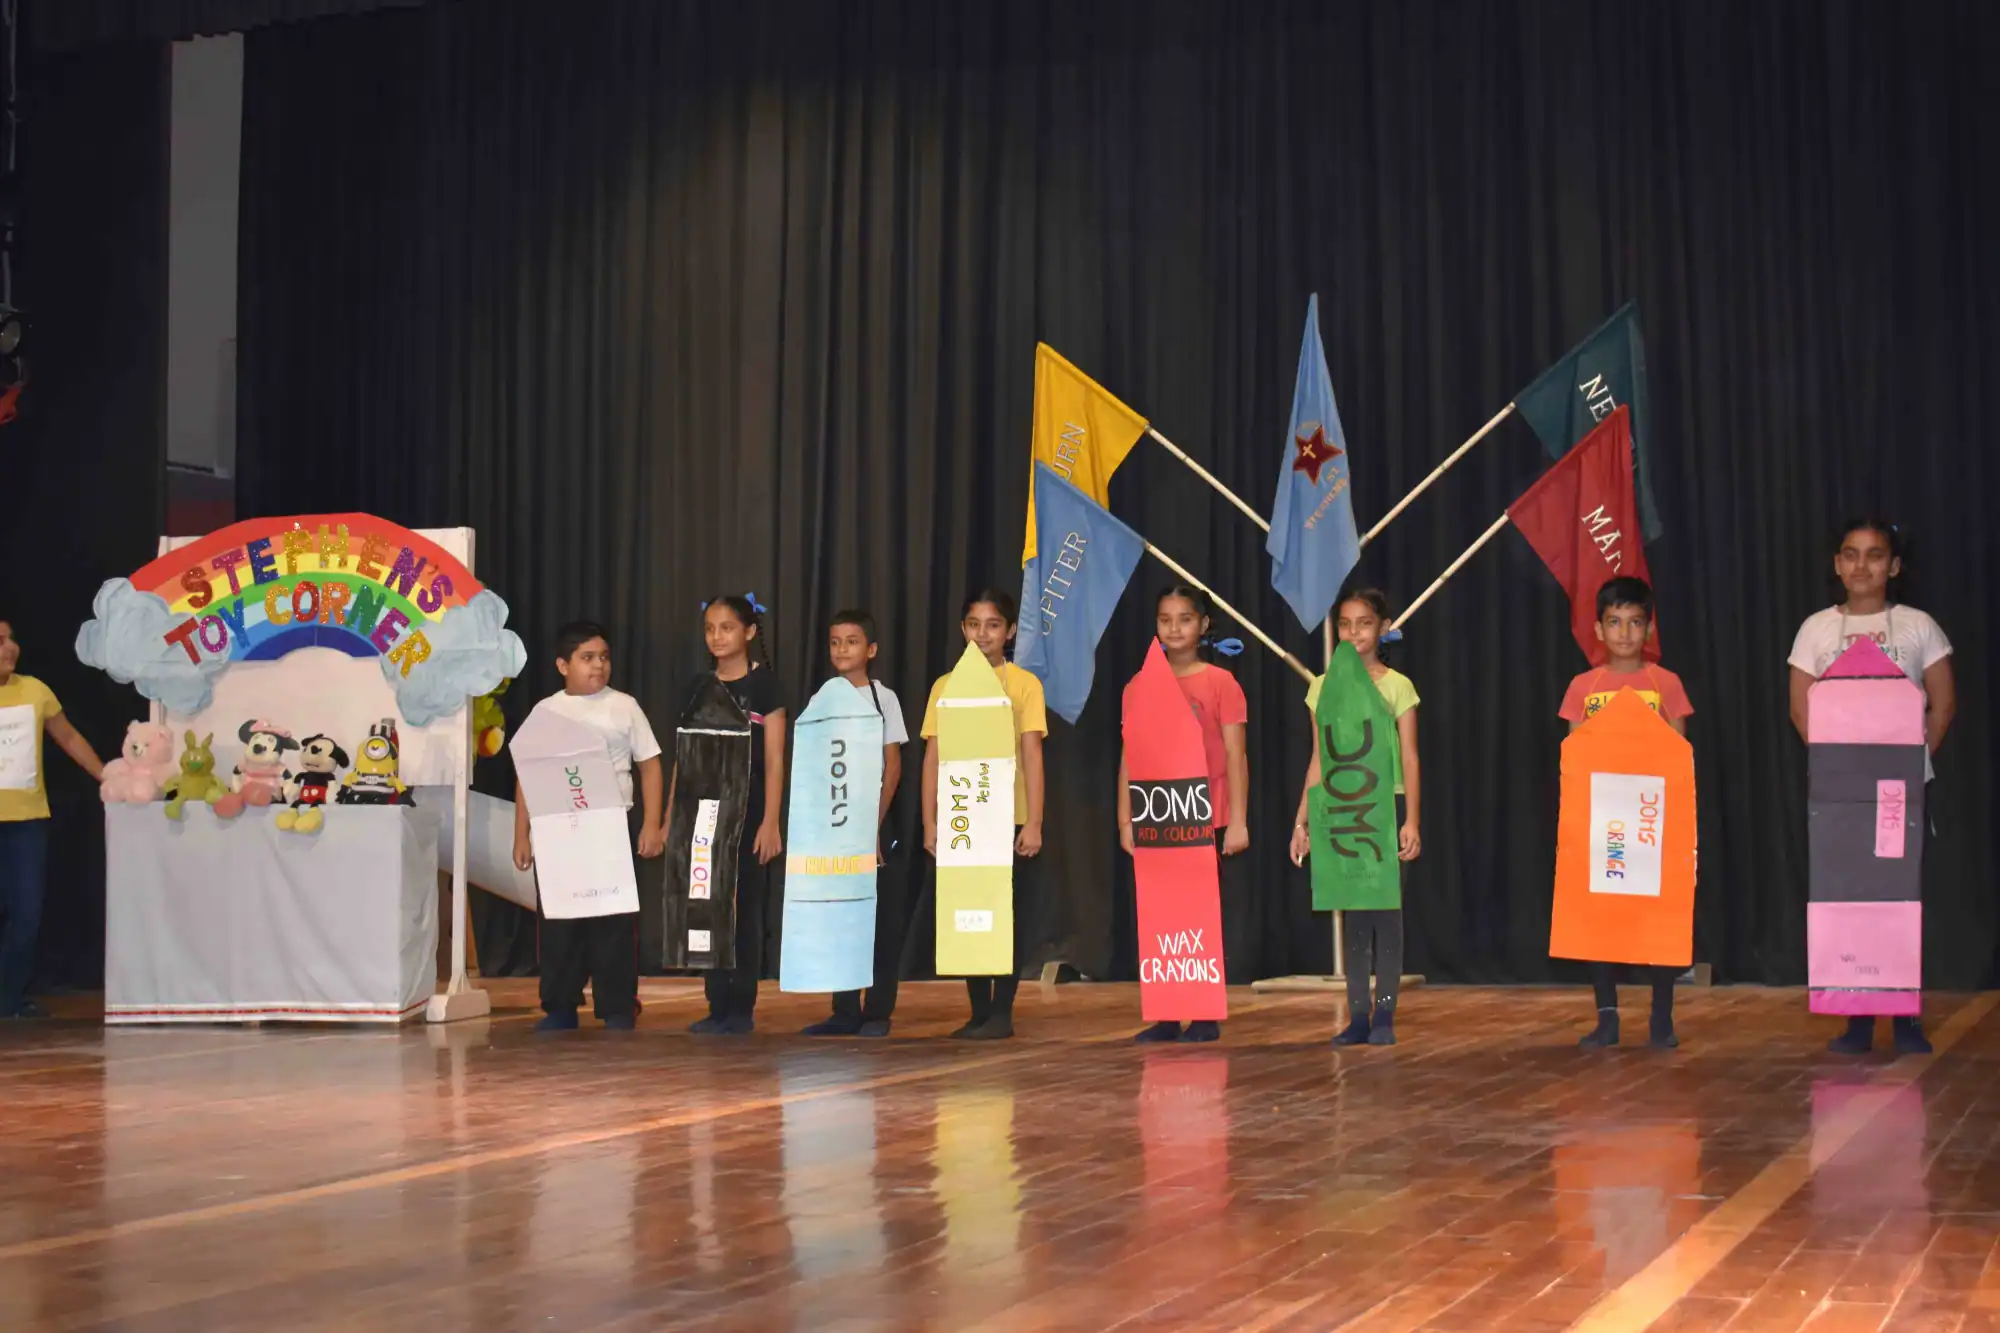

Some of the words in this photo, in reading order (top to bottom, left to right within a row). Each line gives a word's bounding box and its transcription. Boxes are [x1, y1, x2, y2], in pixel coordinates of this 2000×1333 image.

[180, 523, 454, 614] STEPHEN'S
[163, 597, 251, 665] TOY
[264, 581, 432, 680] CORNER
[565, 766, 588, 809] DOMS
[830, 740, 848, 827] DOMS
[950, 775, 971, 850] DOMS
[1129, 784, 1212, 822] DOMS
[1323, 718, 1384, 863] DOMS
[1138, 827, 1158, 841] RED
[1163, 825, 1213, 841] COLOUR
[1606, 819, 1626, 879] ORANGE
[1637, 792, 1659, 847] DOMS
[691, 834, 709, 897] DOMS
[1140, 957, 1220, 984] CRAYONS
[1156, 928, 1204, 956] WAX
